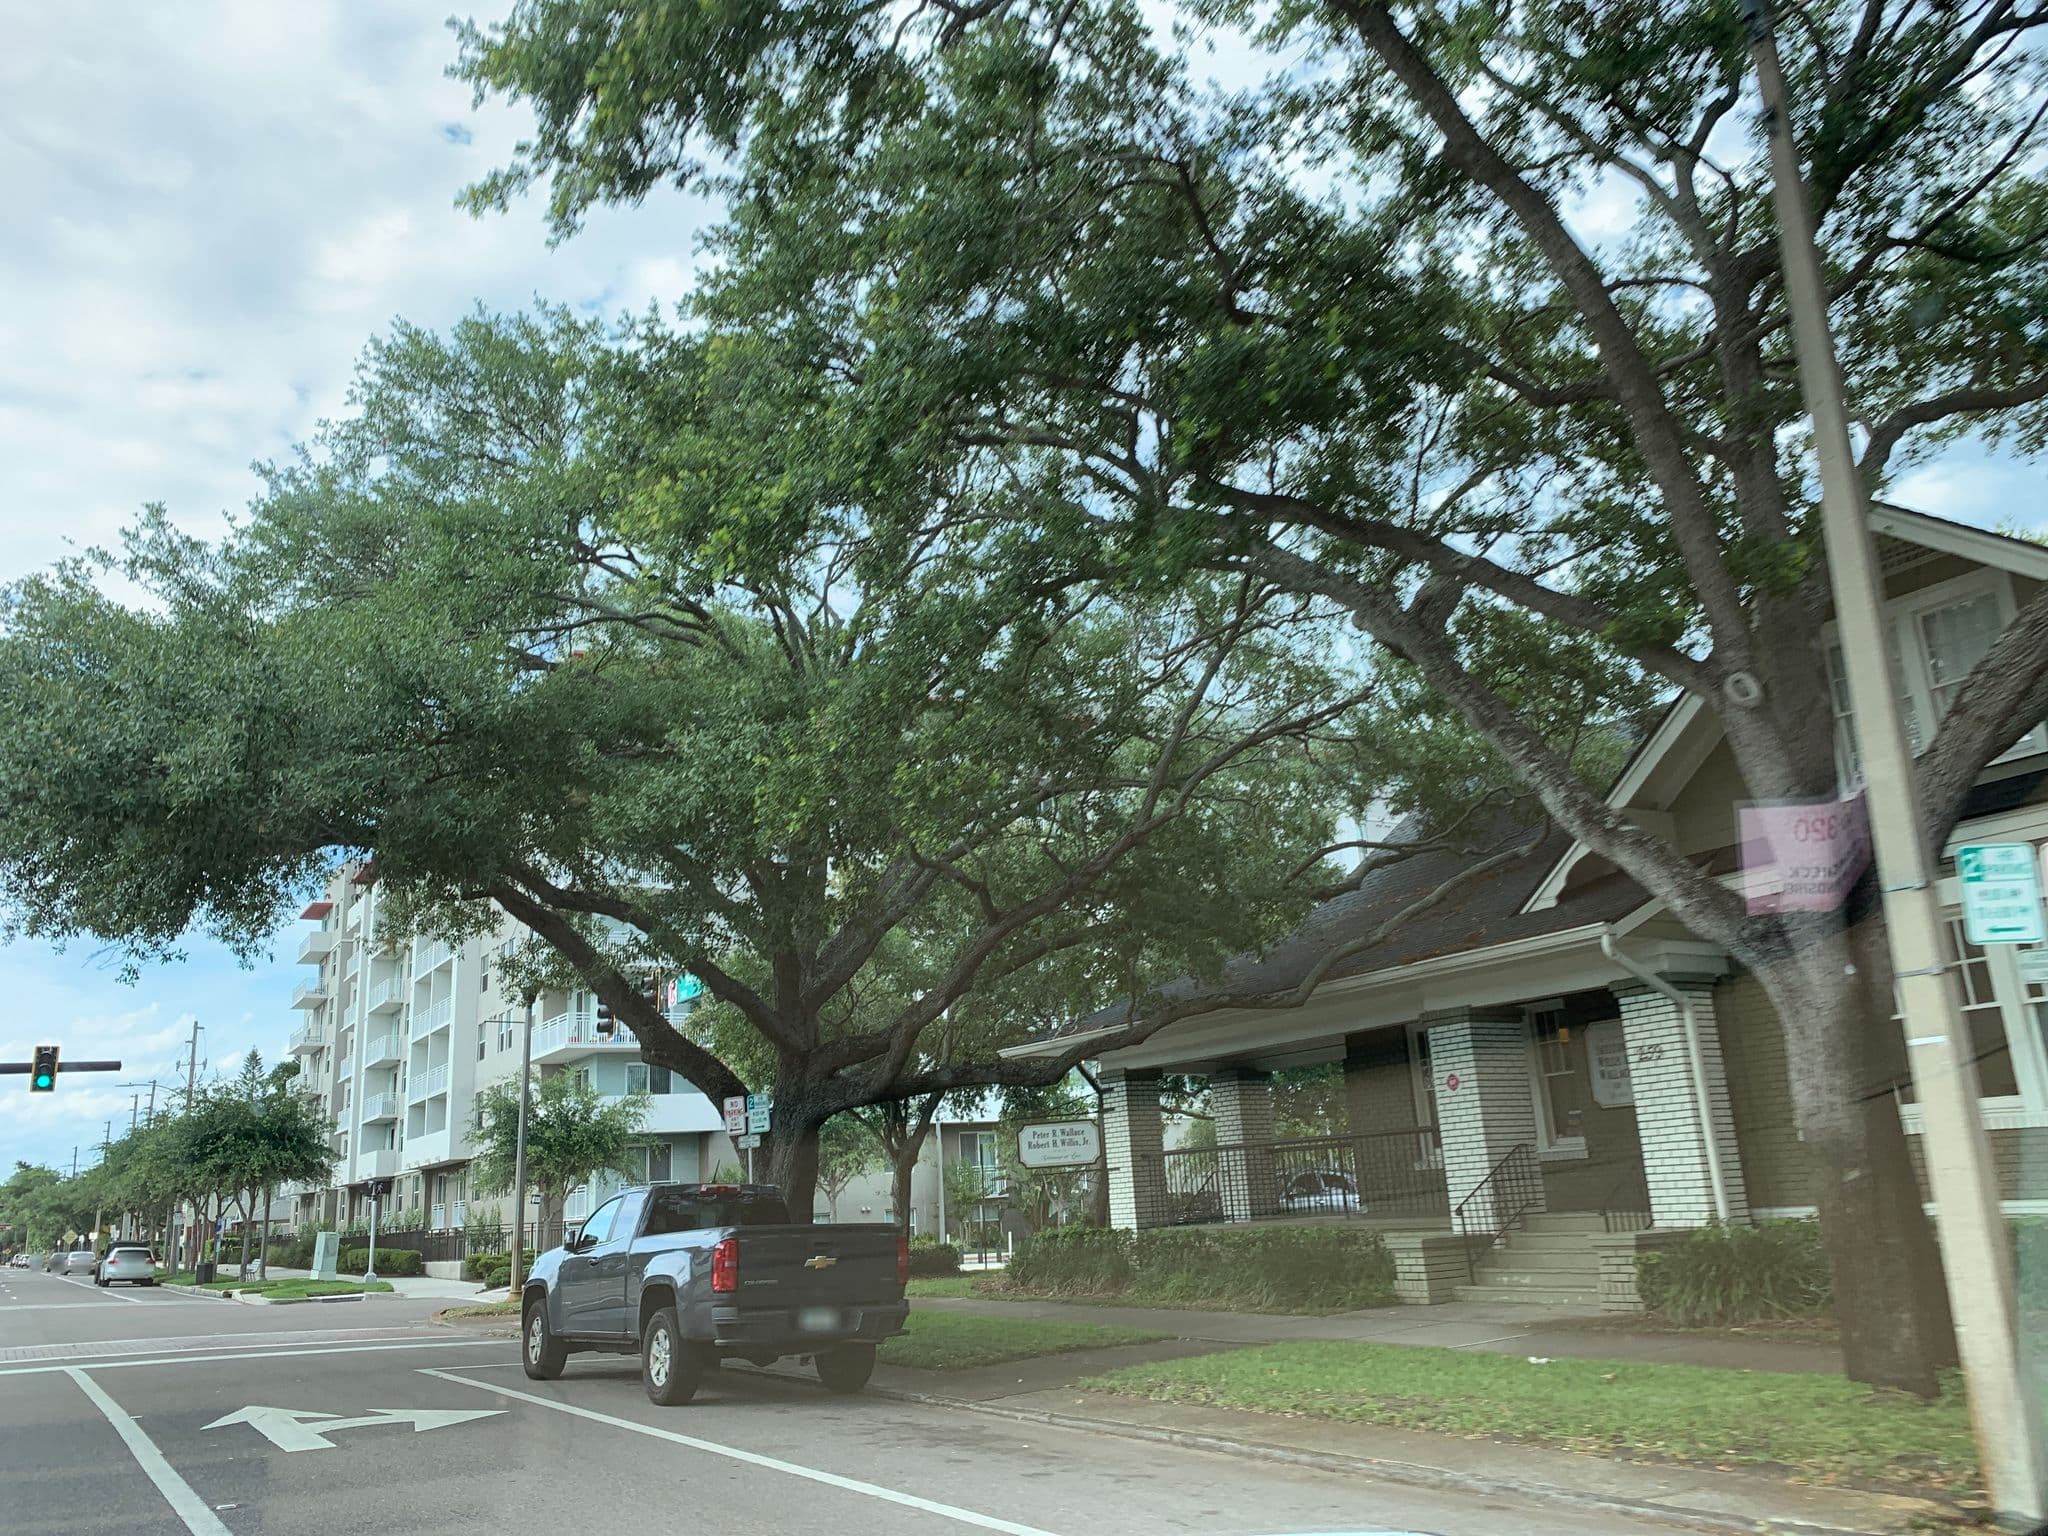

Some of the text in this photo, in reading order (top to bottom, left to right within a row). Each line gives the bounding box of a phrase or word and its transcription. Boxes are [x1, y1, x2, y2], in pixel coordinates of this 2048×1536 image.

[1032, 1130, 1050, 1139] Peter
[1060, 1128, 1085, 1137] Wallace
[1028, 1140, 1050, 1150] Robert
